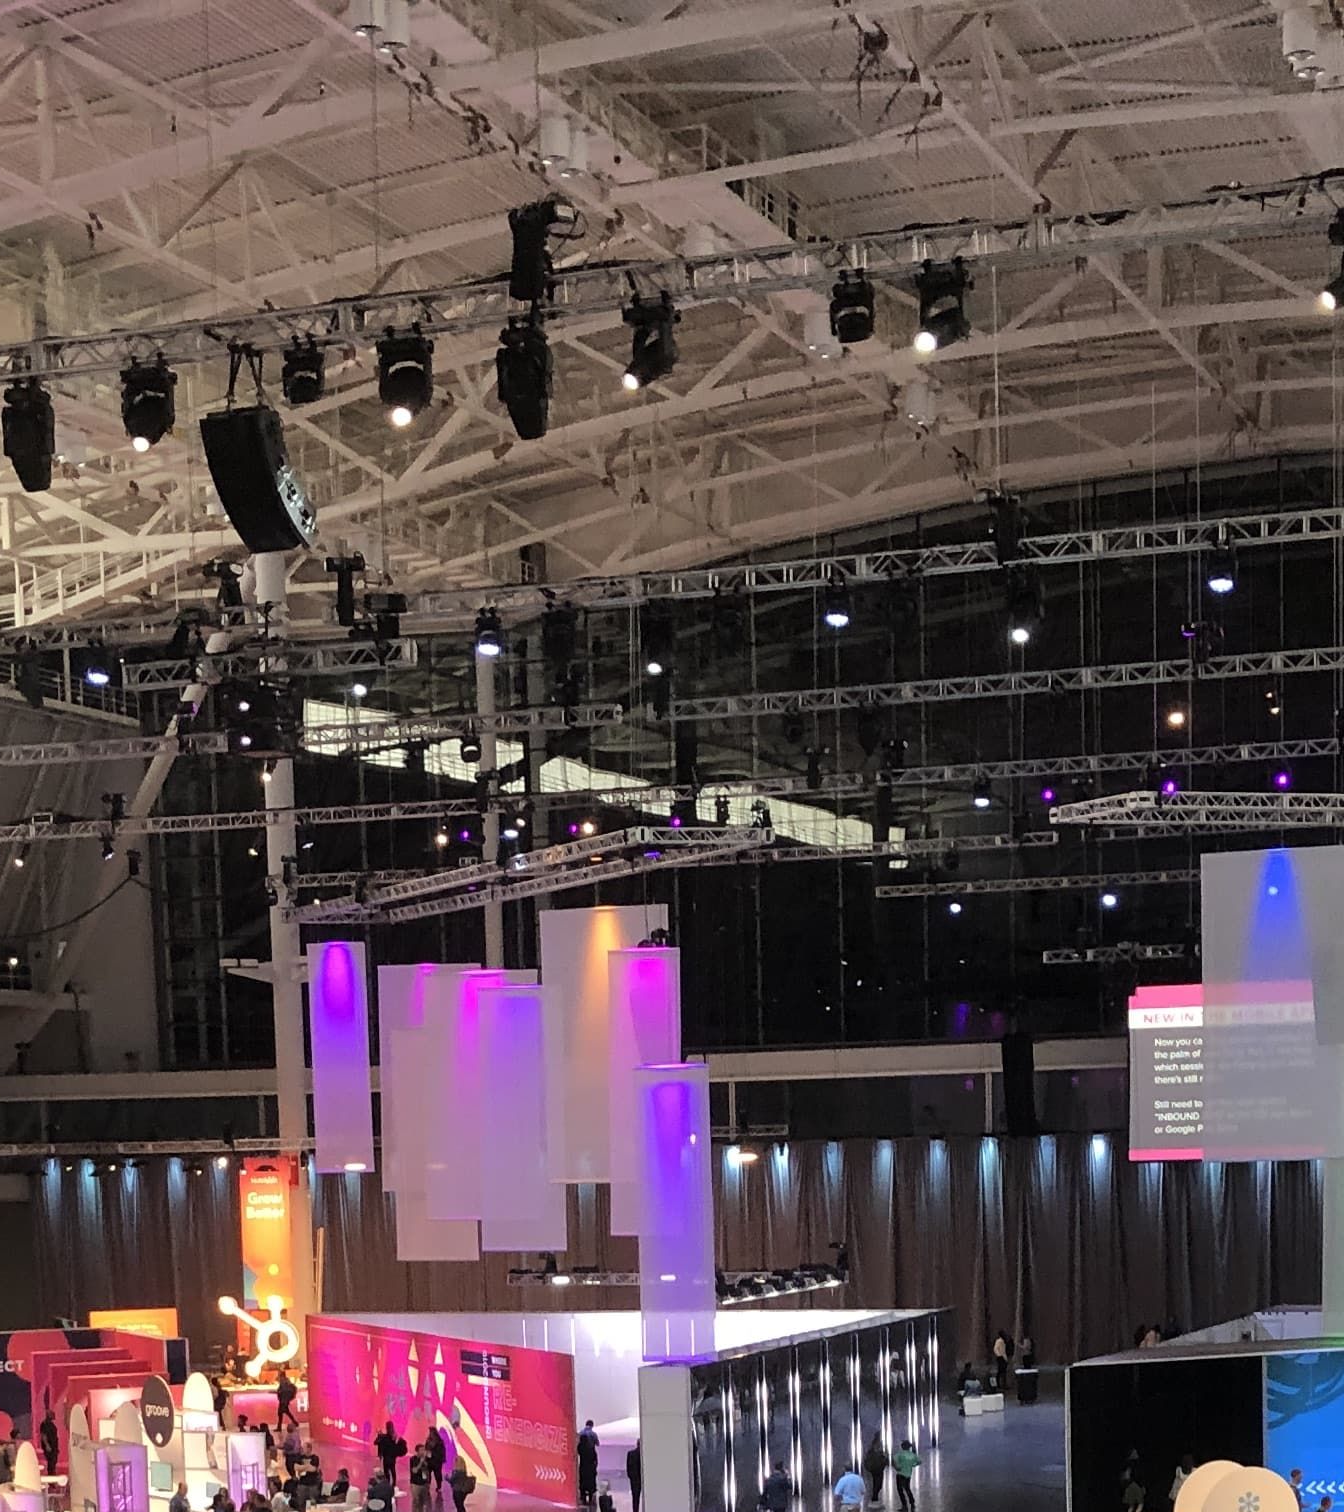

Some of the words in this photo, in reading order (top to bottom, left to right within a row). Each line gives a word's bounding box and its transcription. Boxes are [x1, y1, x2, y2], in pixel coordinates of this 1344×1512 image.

[1143, 1013, 1175, 1024] NEW
[1181, 1012, 1194, 1023] IN
[1154, 1038, 1173, 1047] Now
[1175, 1039, 1191, 1048] you
[1193, 1038, 1203, 1046] ca
[1154, 1050, 1170, 1060] the
[1171, 1050, 1190, 1061] palm
[1192, 1049, 1201, 1058] of
[1154, 1062, 1179, 1072] which
[1154, 1074, 1182, 1085] there's
[1183, 1074, 1199, 1083] still
[1154, 1099, 1170, 1109] Still
[1172, 1099, 1192, 1109] need
[1193, 1100, 1203, 1108] to
[1154, 1126, 1164, 1134] or
[1166, 1124, 1195, 1135] Google
[145, 1403, 169, 1418] groove
